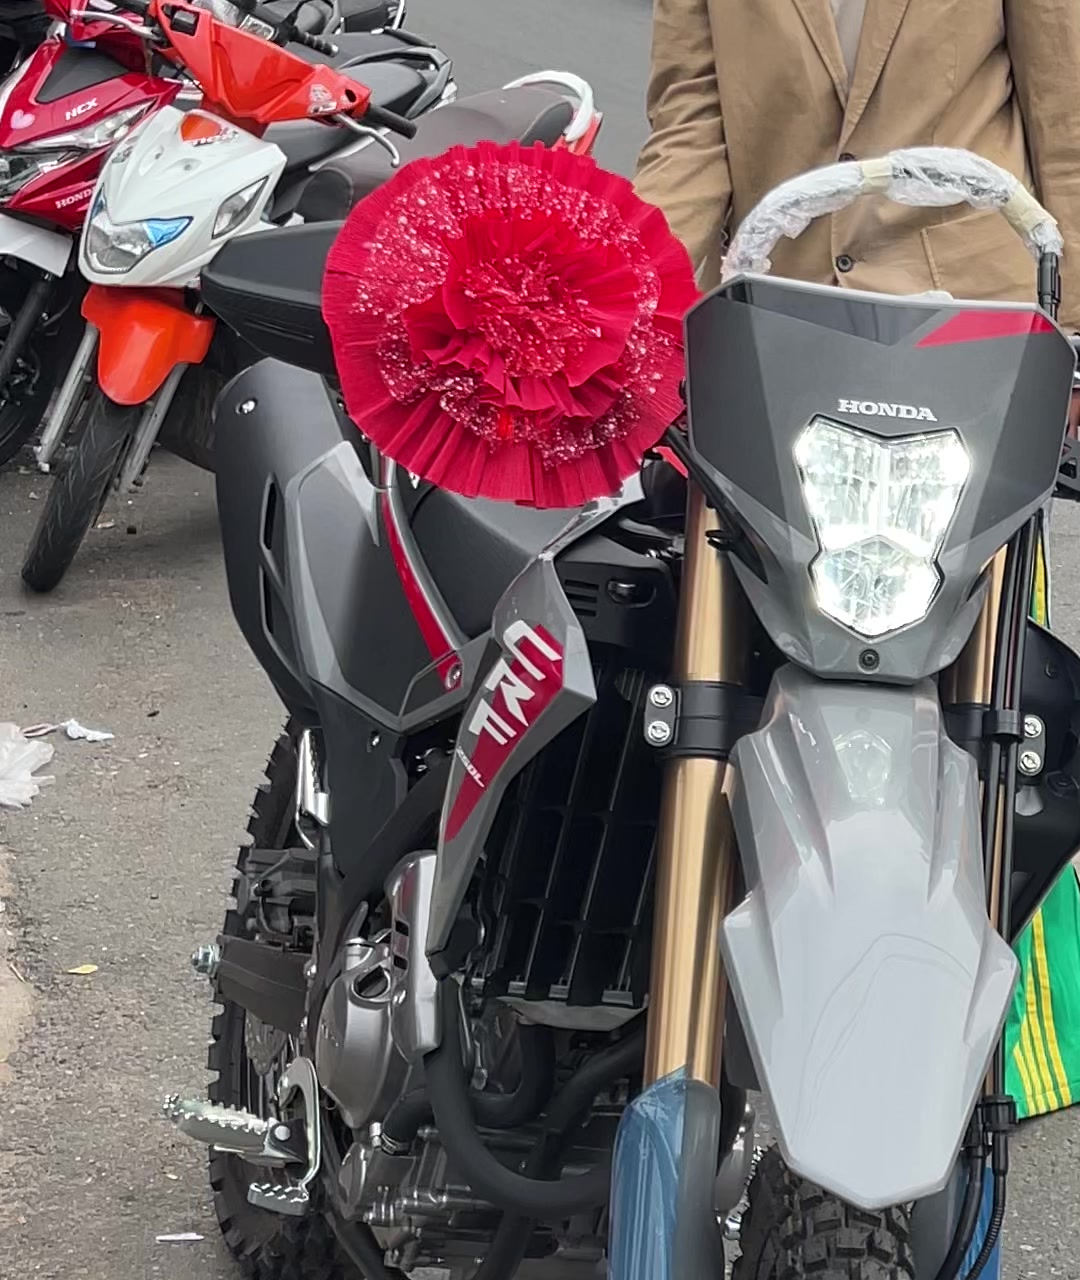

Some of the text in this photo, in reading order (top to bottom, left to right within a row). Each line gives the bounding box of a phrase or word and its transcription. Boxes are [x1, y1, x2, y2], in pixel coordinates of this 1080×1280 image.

[65, 97, 99, 121] NCX
[55, 188, 92, 209] HOND
[837, 398, 938, 422] HONDA
[467, 619, 563, 746] CRF
